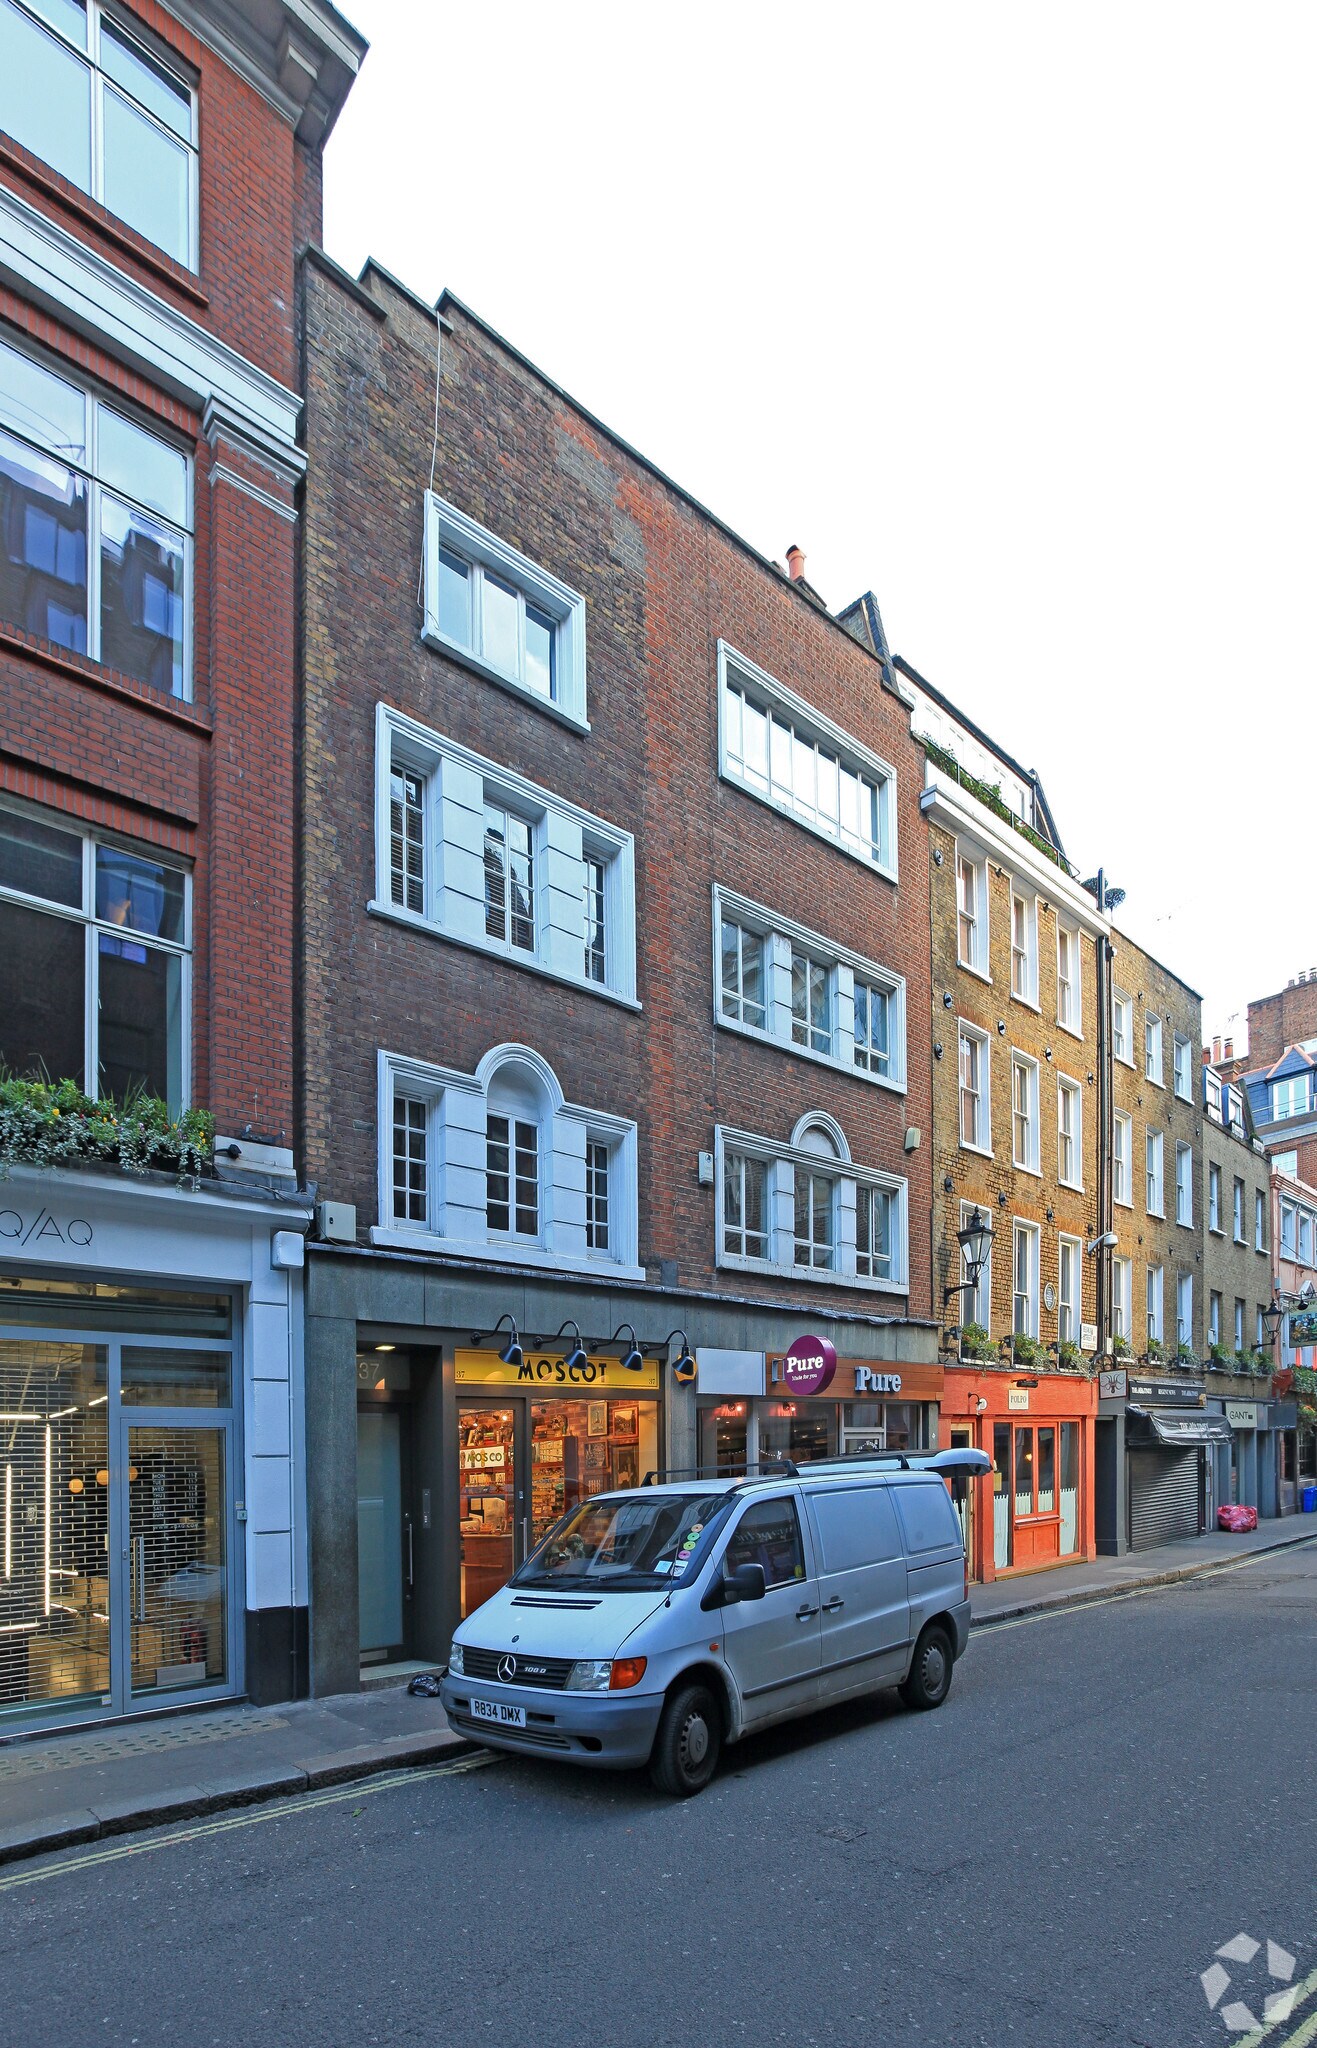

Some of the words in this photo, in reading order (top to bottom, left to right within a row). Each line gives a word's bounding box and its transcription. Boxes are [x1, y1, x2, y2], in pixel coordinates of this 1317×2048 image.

[358, 1362, 380, 1380] 37
[517, 1359, 608, 1383] MOSCOT
[786, 1356, 824, 1373] Pure
[456, 1370, 465, 1379] 37
[854, 1366, 902, 1392] Pure
[1010, 1395, 1027, 1403] POLPO
[1229, 1410, 1248, 1420] GANT
[467, 1452, 505, 1463] MOSCO
[474, 1700, 498, 1719] R834
[500, 1705, 521, 1723] DMX
